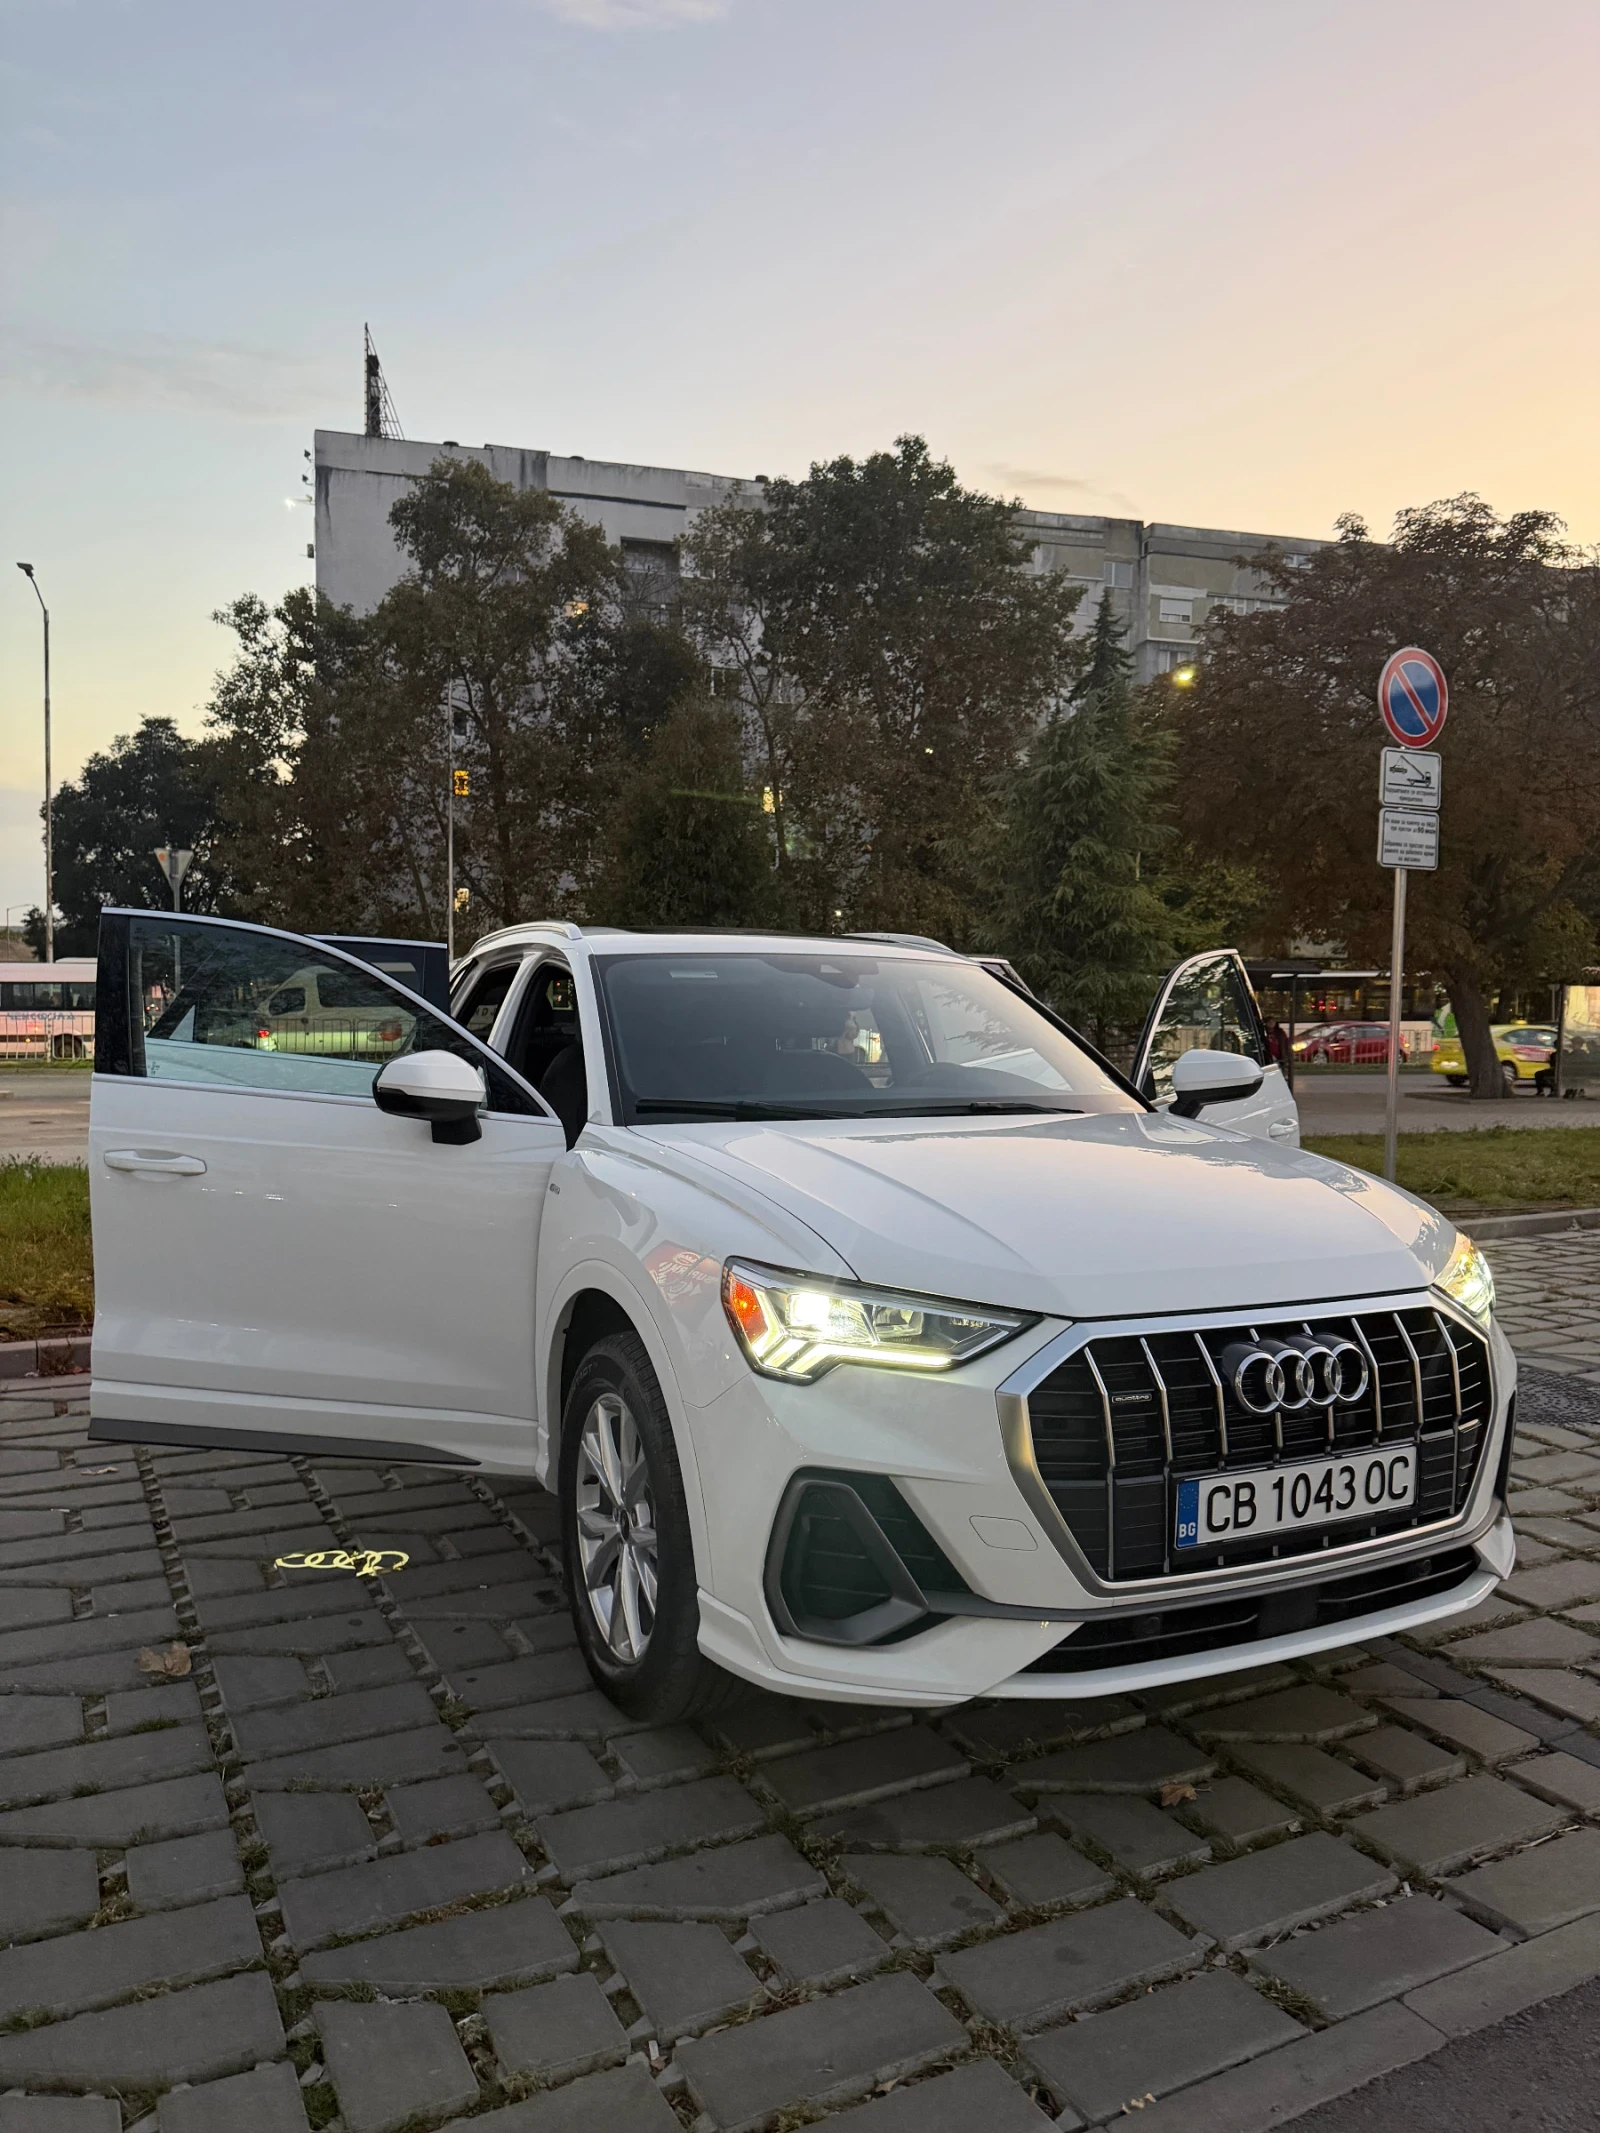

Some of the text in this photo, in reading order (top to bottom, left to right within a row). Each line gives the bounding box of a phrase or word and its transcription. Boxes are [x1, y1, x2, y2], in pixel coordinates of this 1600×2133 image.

[1115, 1394, 1150, 1402] quattro
[1206, 1481, 1257, 1533] CB
[1272, 1465, 1356, 1522] 1043
[1179, 1522, 1196, 1538] BG
